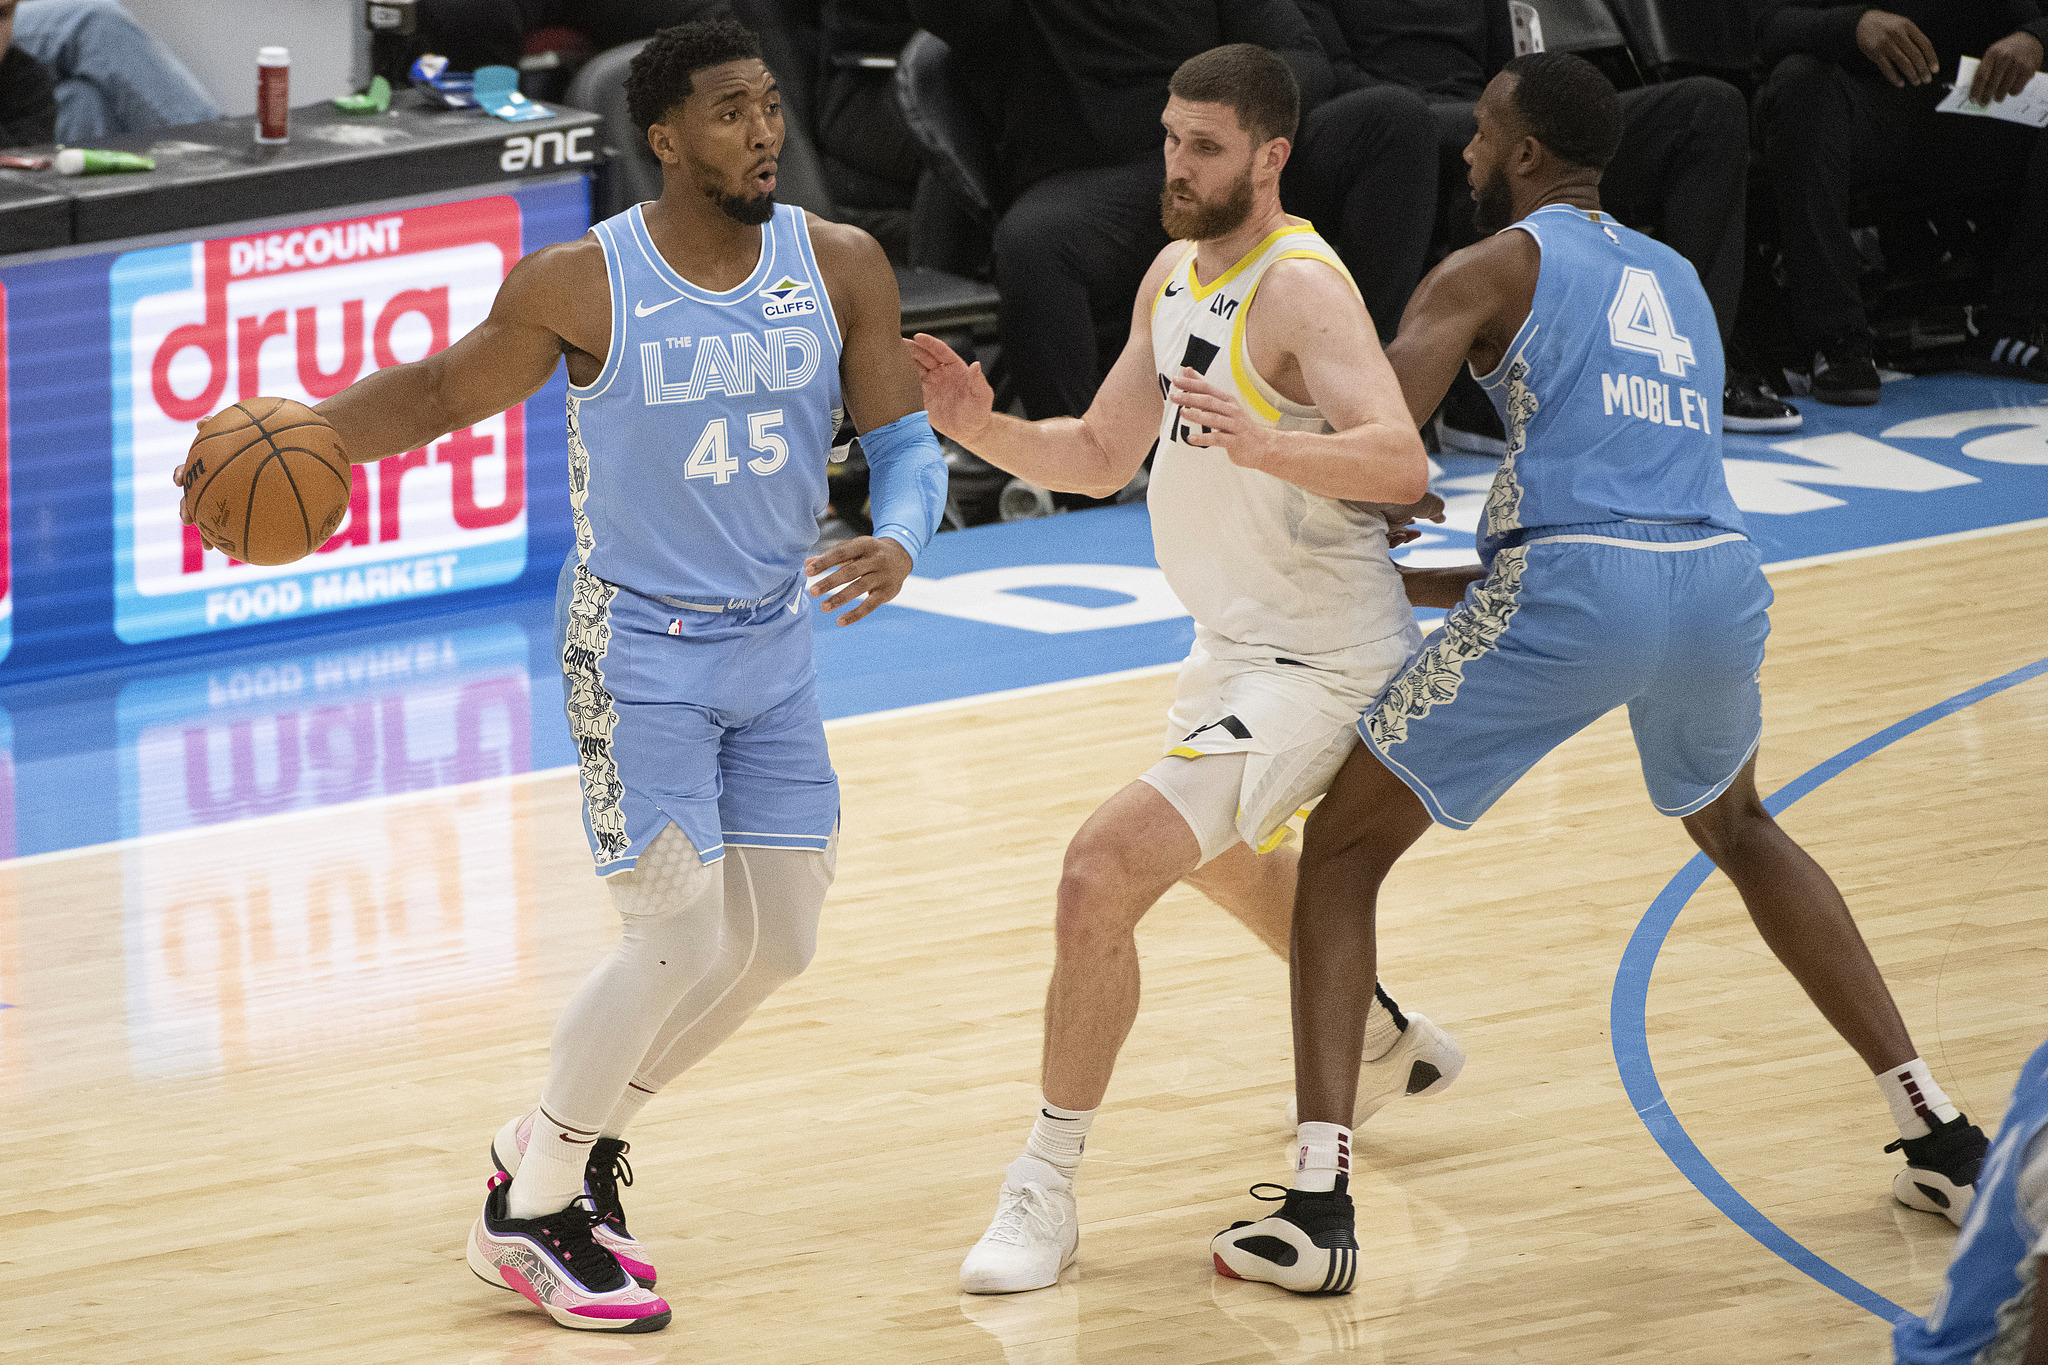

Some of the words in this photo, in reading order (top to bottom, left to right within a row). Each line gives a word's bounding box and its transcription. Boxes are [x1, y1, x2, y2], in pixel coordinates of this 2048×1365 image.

[500, 128, 595, 172] anc
[230, 217, 404, 275] DISCOUNT
[765, 299, 815, 318] CLIFFS
[1607, 266, 1696, 378] 4
[640, 327, 821, 406] LAND
[665, 336, 693, 350] THE
[1601, 372, 1711, 435] MOBLEY
[683, 409, 789, 486] 45
[206, 578, 302, 627] FOOD
[310, 554, 459, 608] MARKET
